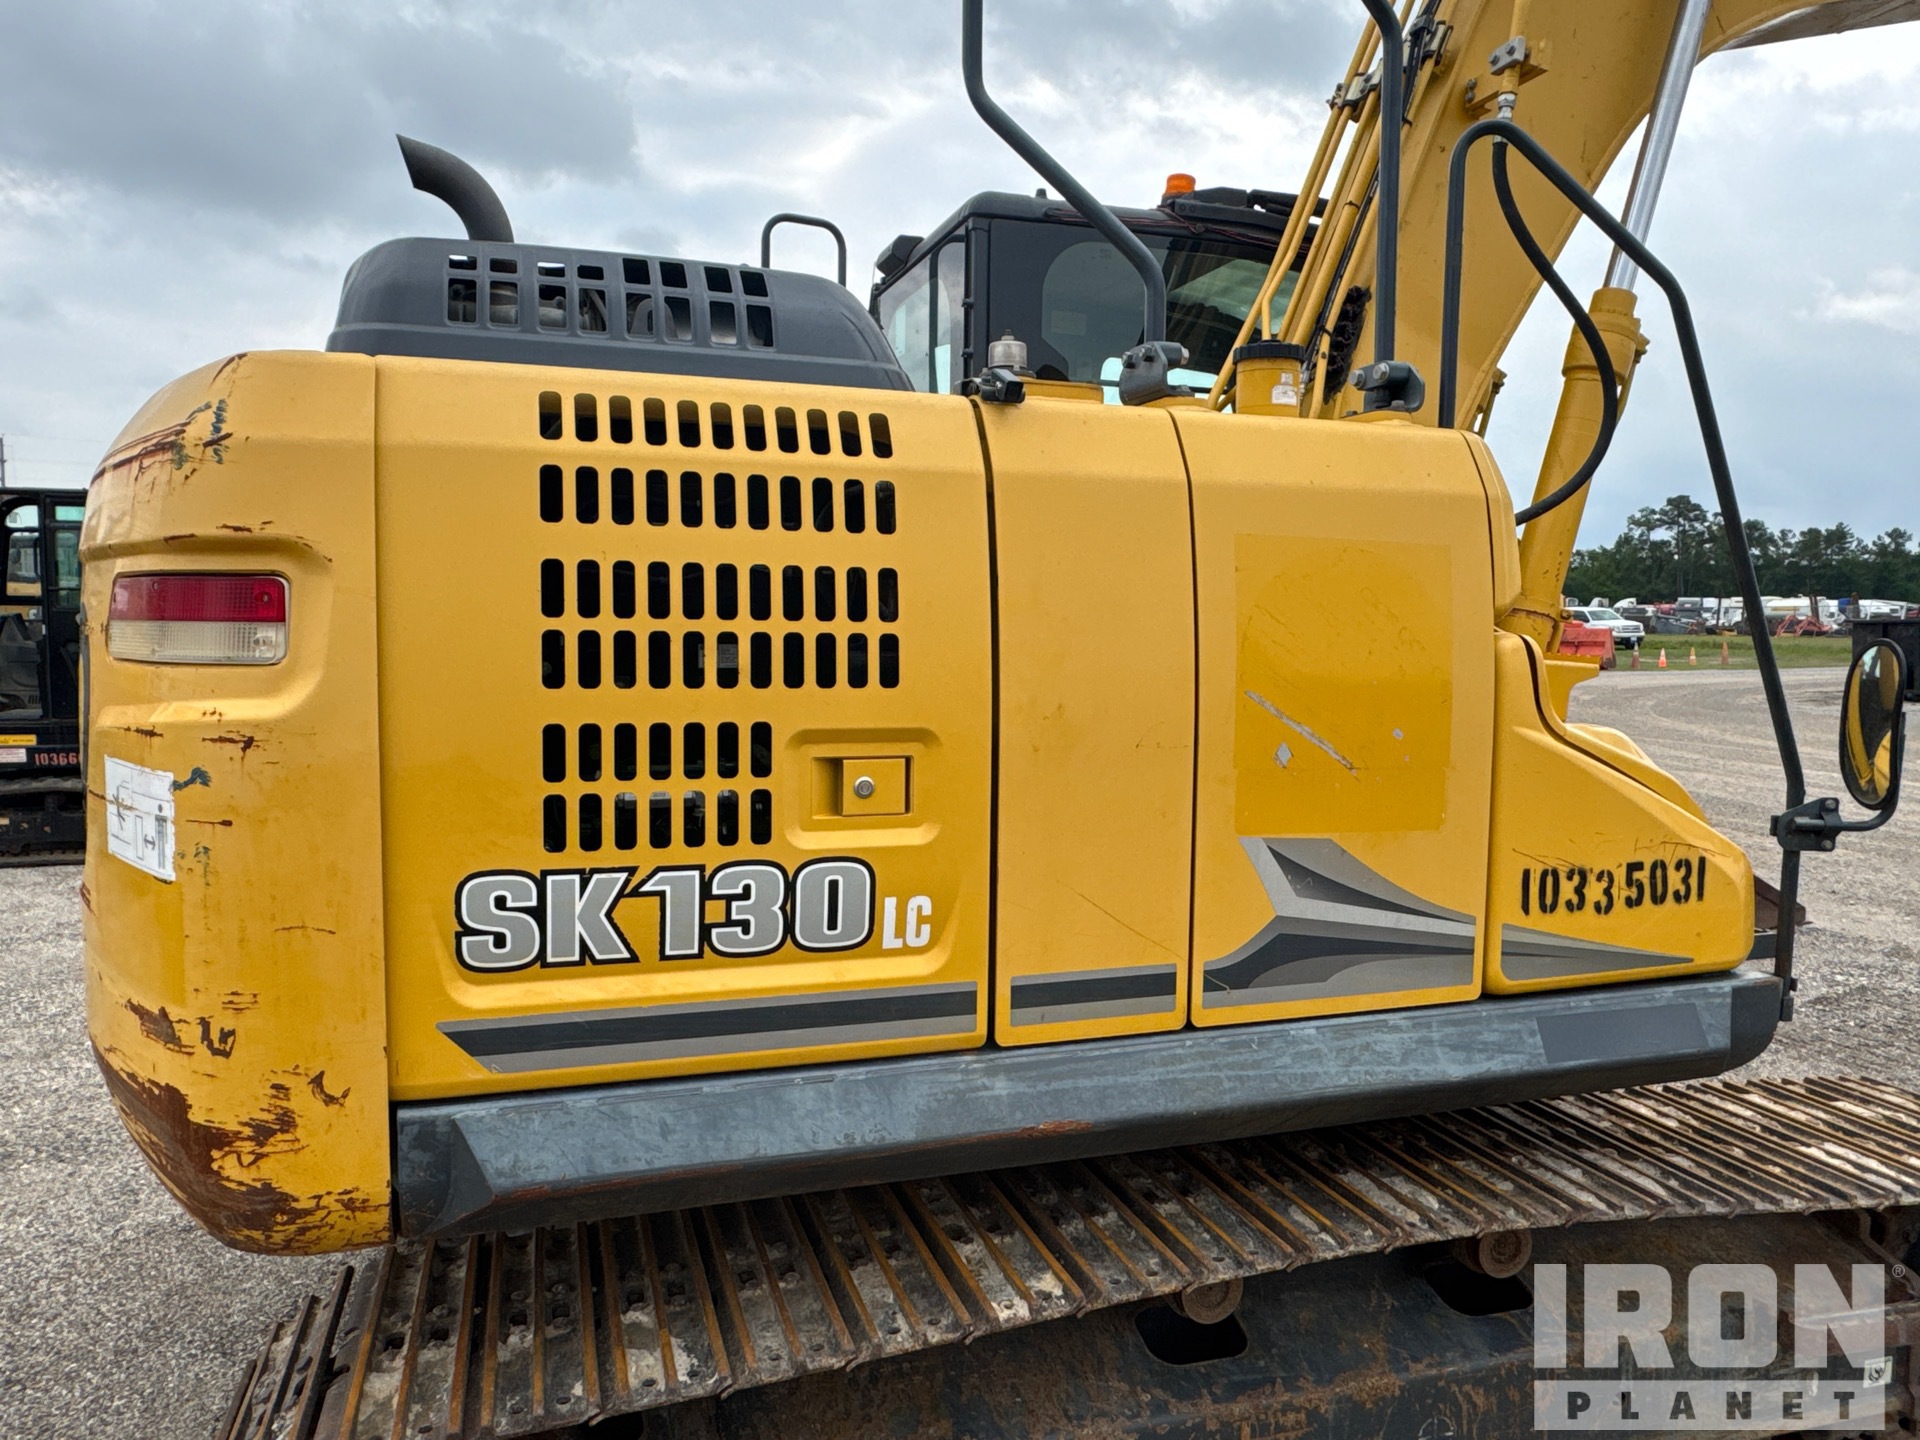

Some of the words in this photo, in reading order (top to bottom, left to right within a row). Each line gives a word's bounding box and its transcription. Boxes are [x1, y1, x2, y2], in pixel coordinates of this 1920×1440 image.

[35, 752, 81, 766] 10366
[455, 856, 875, 974] SK130
[882, 895, 932, 950] LC
[1521, 855, 1706, 916] 10335031
